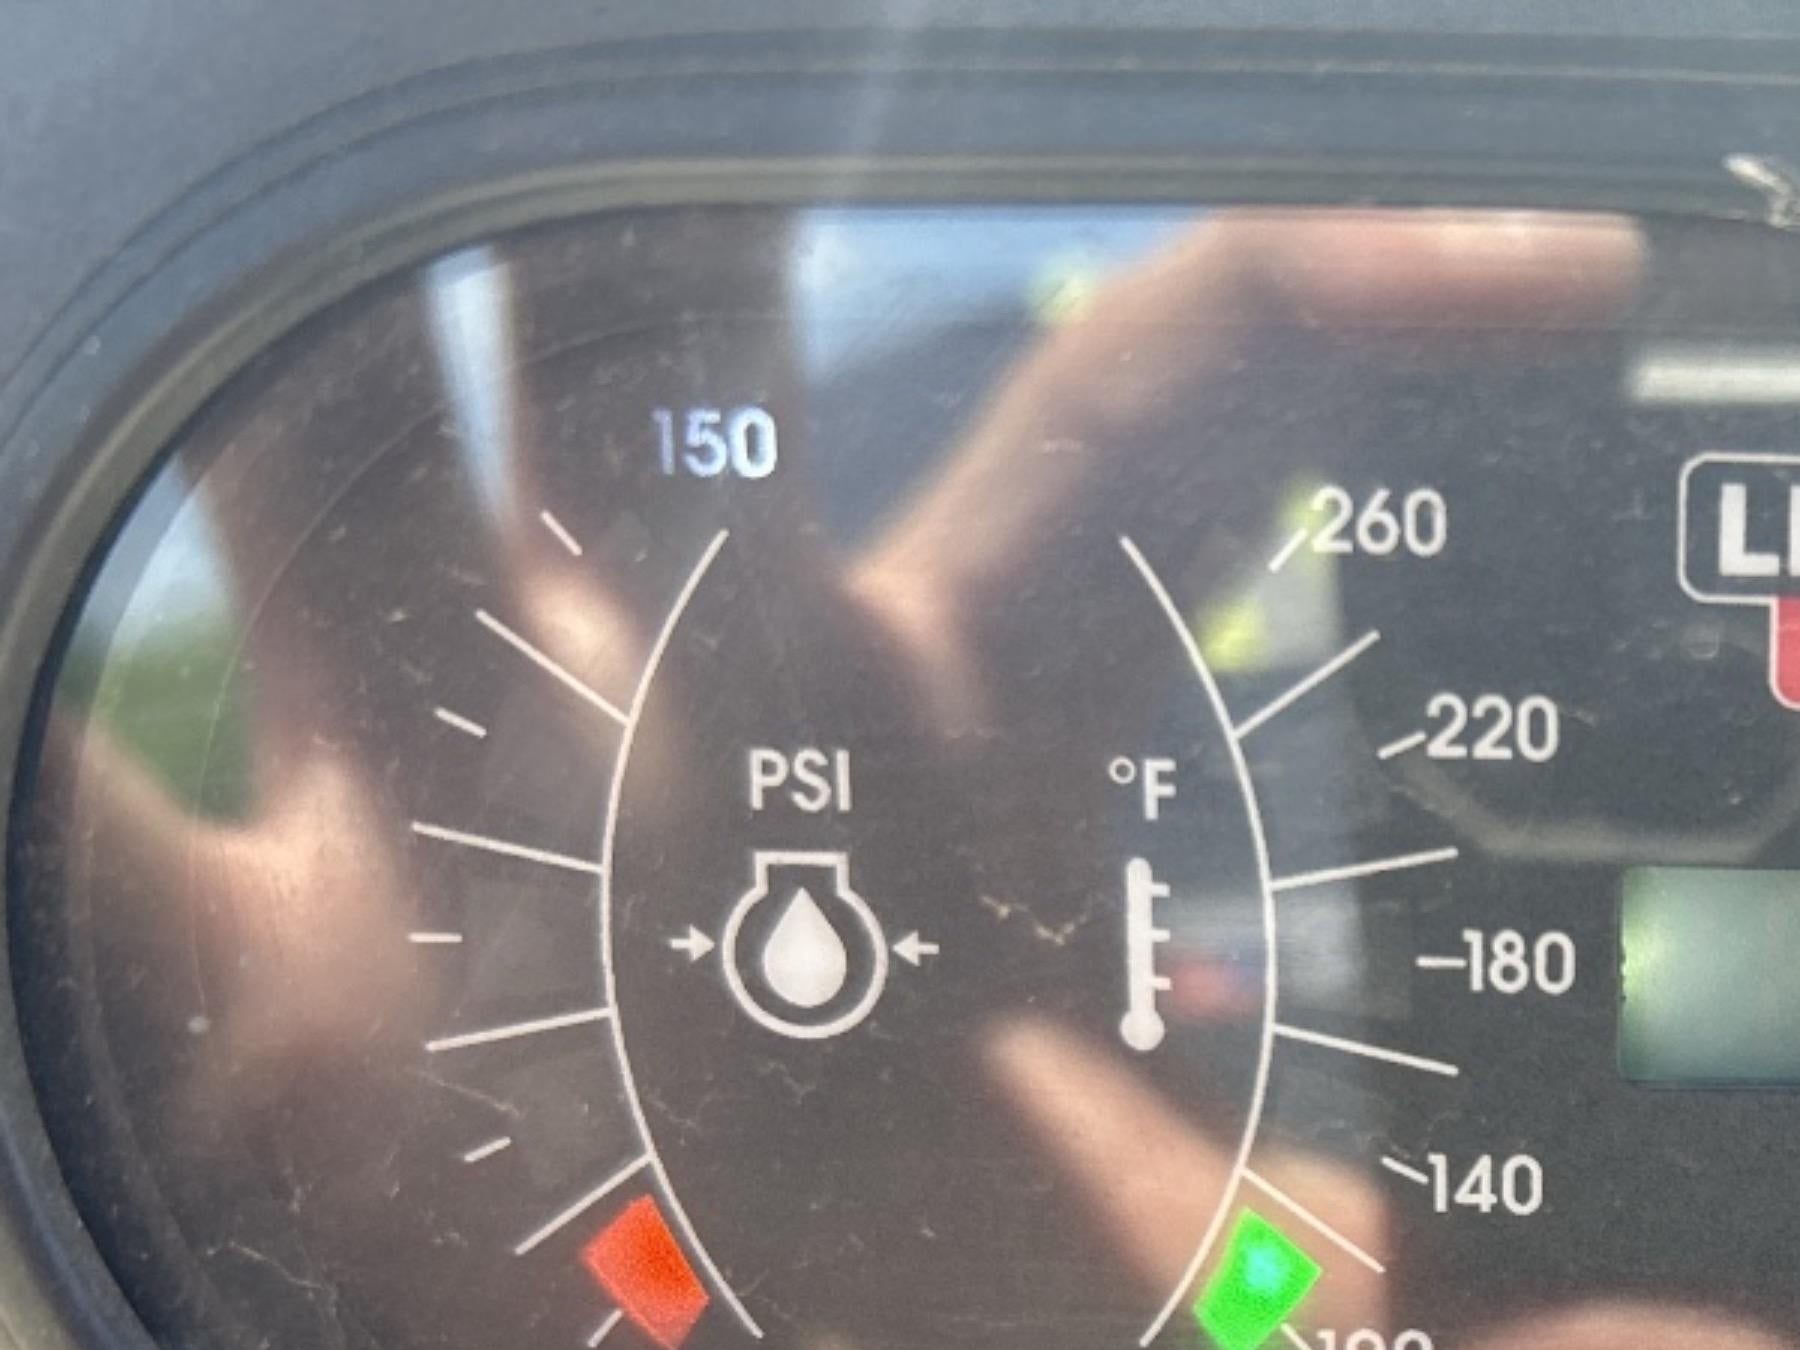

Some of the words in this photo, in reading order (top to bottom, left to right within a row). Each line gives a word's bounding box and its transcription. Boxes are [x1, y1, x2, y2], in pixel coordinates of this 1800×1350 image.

[652, 406, 779, 478] 150
[1309, 486, 1447, 558] 260
[1425, 695, 1558, 761] 220
[748, 747, 852, 813] PSI
[1464, 929, 1576, 995] 180
[1427, 1153, 1544, 1215] 140
